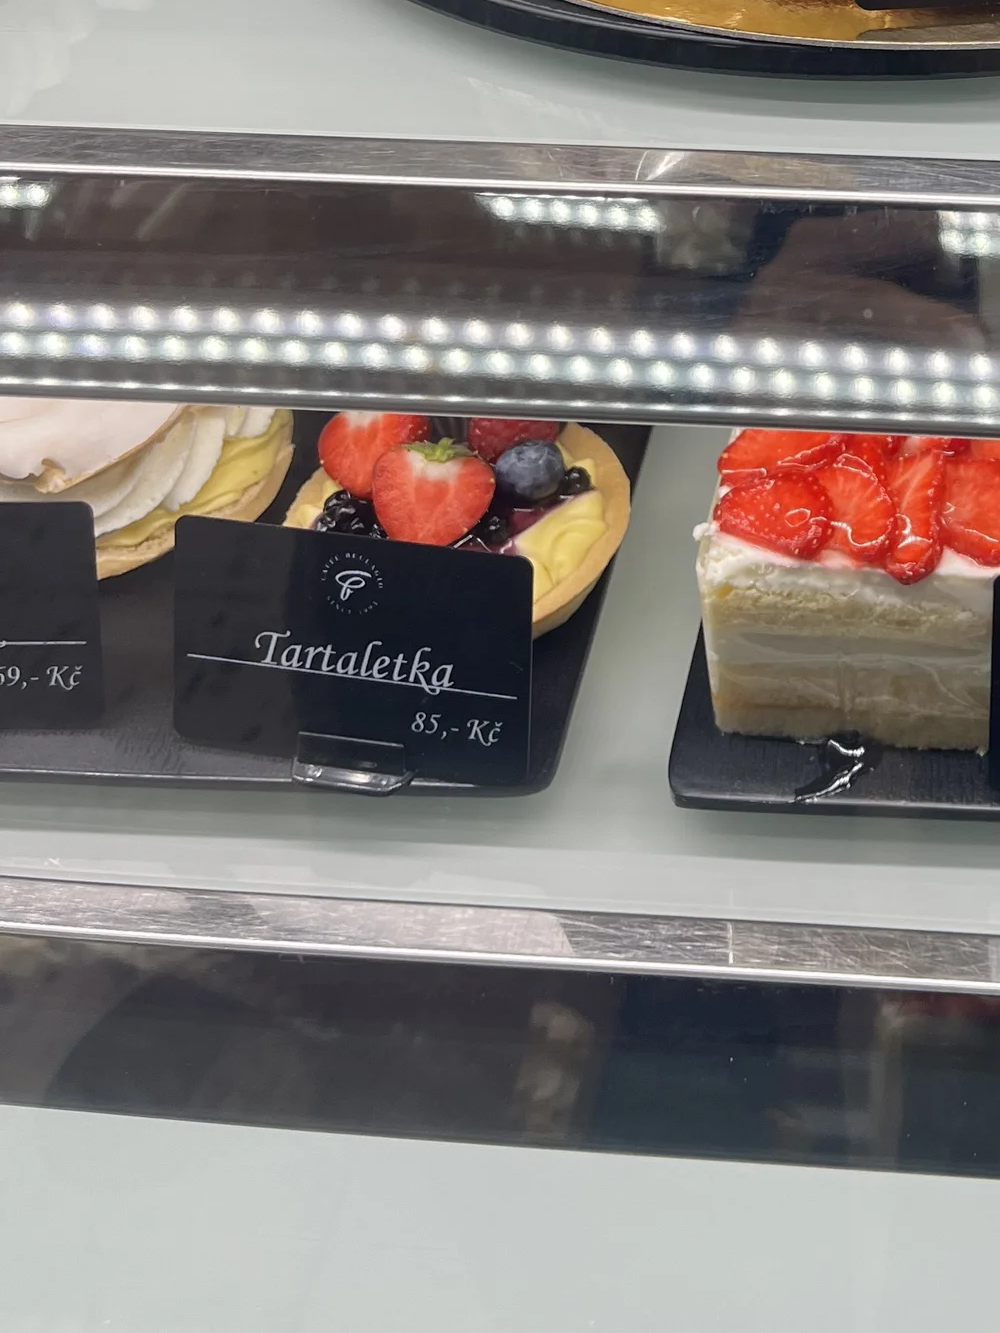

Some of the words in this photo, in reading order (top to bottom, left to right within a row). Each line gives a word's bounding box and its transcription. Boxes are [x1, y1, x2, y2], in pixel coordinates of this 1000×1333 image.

[46, 665, 83, 691] Kč
[255, 631, 455, 695] Tartaletka
[411, 711, 460, 740] 85,-
[467, 719, 503, 747] Kč
